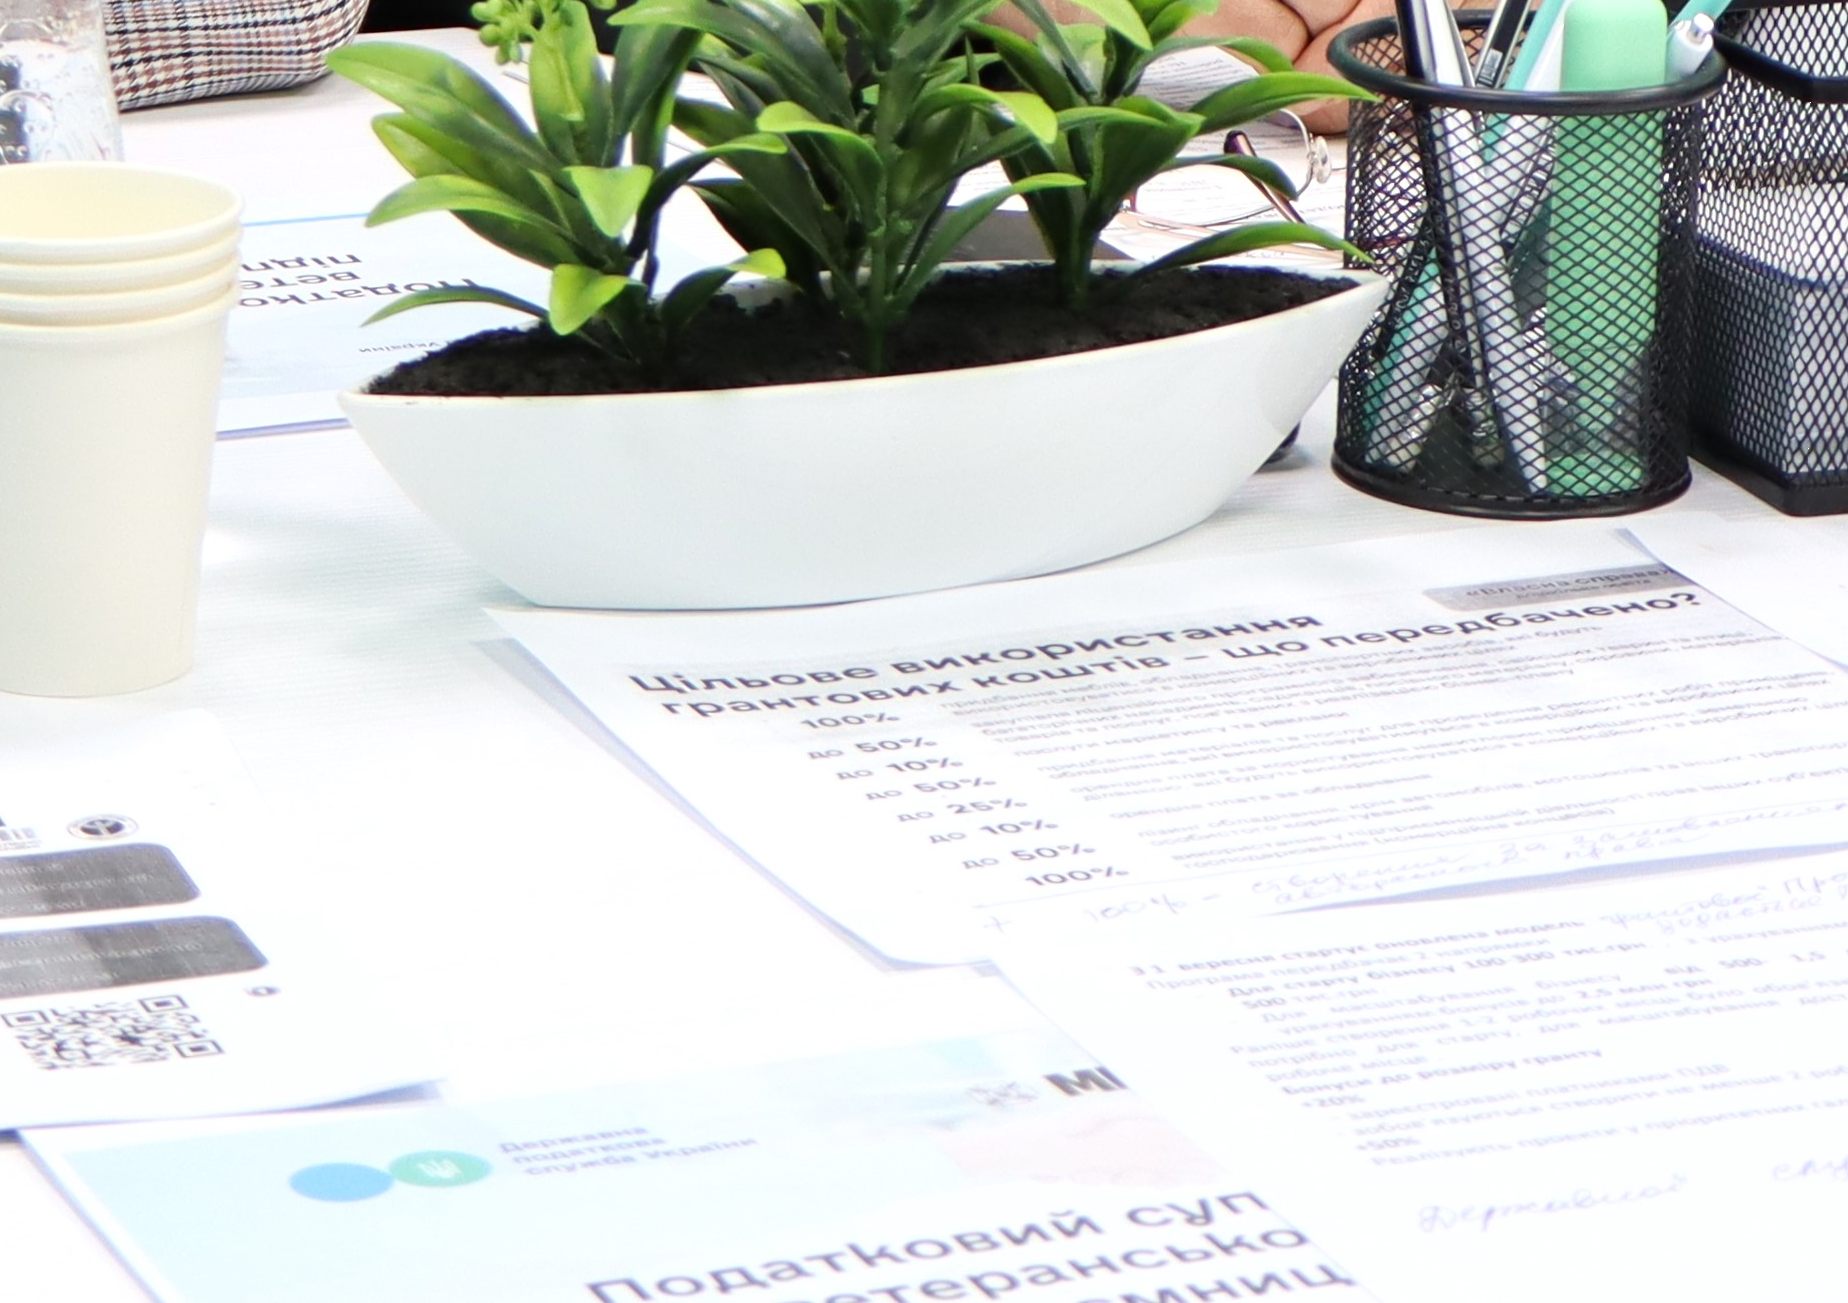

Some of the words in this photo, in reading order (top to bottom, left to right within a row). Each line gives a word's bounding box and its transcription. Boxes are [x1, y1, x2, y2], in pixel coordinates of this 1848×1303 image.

[627, 661, 879, 696] Цільове
[890, 613, 1324, 676] використання
[661, 678, 961, 718] грантових
[971, 654, 1171, 689] коштів
[1223, 638, 1311, 660] що
[1320, 592, 1702, 647] передбачено?
[800, 710, 901, 729] 100%
[808, 748, 845, 760] до
[855, 735, 938, 754] 50%
[836, 768, 873, 782] до
[885, 755, 964, 774] 10%
[866, 788, 902, 801] до
[913, 774, 997, 794] 50%
[897, 809, 934, 822] до
[946, 795, 1028, 816] 25%
[929, 830, 966, 845] до
[979, 817, 1059, 838] 10%
[962, 855, 1000, 870] до
[1011, 841, 1096, 864] 50%
[1024, 864, 1130, 887] 100%
[1176, 952, 1276, 975] вересня
[1281, 942, 1370, 964] стартує
[1374, 927, 1489, 952] оновлена
[1494, 916, 1587, 939] модель
[1146, 967, 1264, 995] Програма
[1435, 936, 1551, 961] напрямки
[1227, 981, 1275, 999] Для
[1282, 972, 1359, 993] старту
[1366, 960, 1455, 983] бізнесу
[1241, 994, 1286, 1011] 500
[1260, 1006, 1307, 1025] Для
[1328, 982, 1515, 1017] масштабування
[1533, 969, 1622, 992] бізнесу
[1281, 1074, 1371, 1098] Бонуси
[1379, 1071, 1411, 1086] до
[1416, 1057, 1517, 1082] розміру
[1521, 1046, 1603, 1068] гранту
[499, 1125, 649, 1155] Державна
[511, 1137, 668, 1166] податкова
[524, 1153, 638, 1177] служба
[647, 1136, 759, 1162] України
[585, 1209, 1106, 1303] Податковий
[1126, 1191, 1271, 1227] суп
